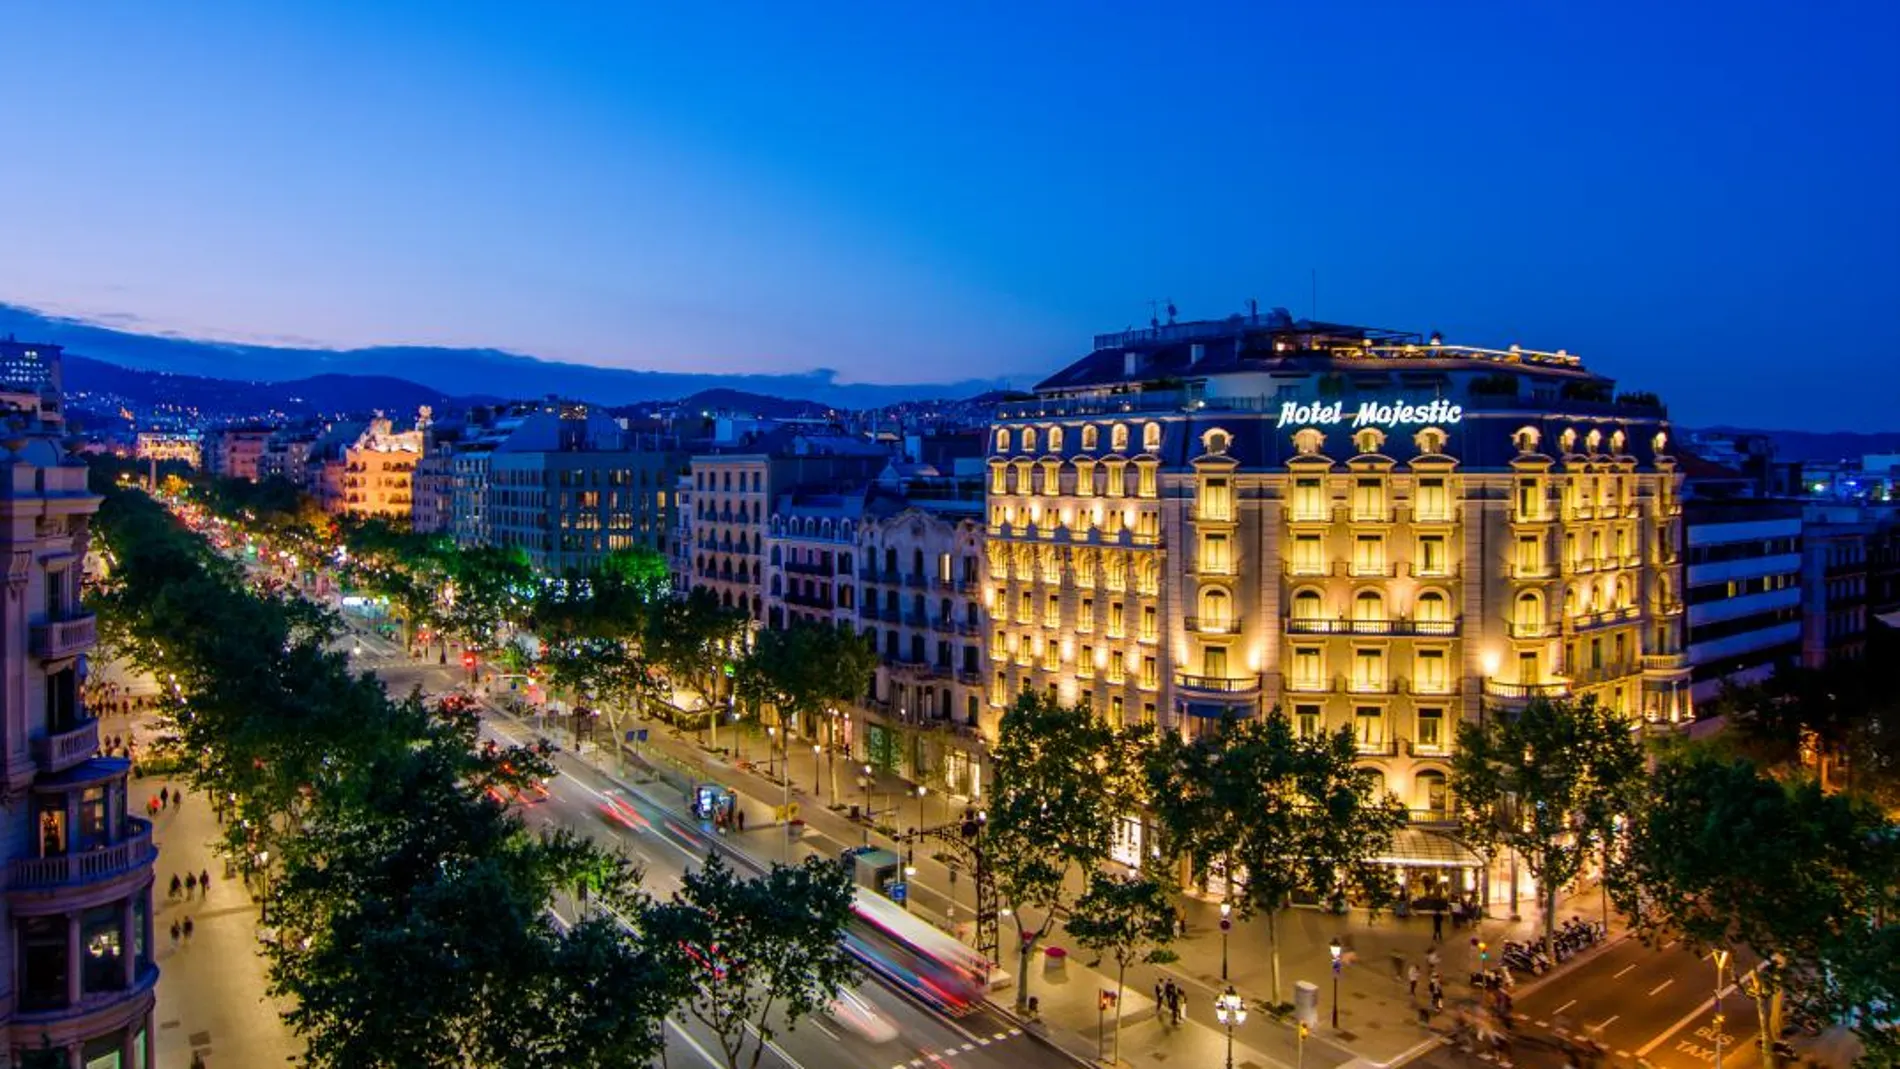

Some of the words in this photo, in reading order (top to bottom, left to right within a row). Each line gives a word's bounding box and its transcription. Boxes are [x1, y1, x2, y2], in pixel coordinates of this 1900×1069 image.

[1277, 400, 1342, 428] Hotel
[1352, 399, 1462, 428] Majestic
[1694, 1026, 1735, 1046] BUS
[1676, 1040, 1718, 1062] TAXI
